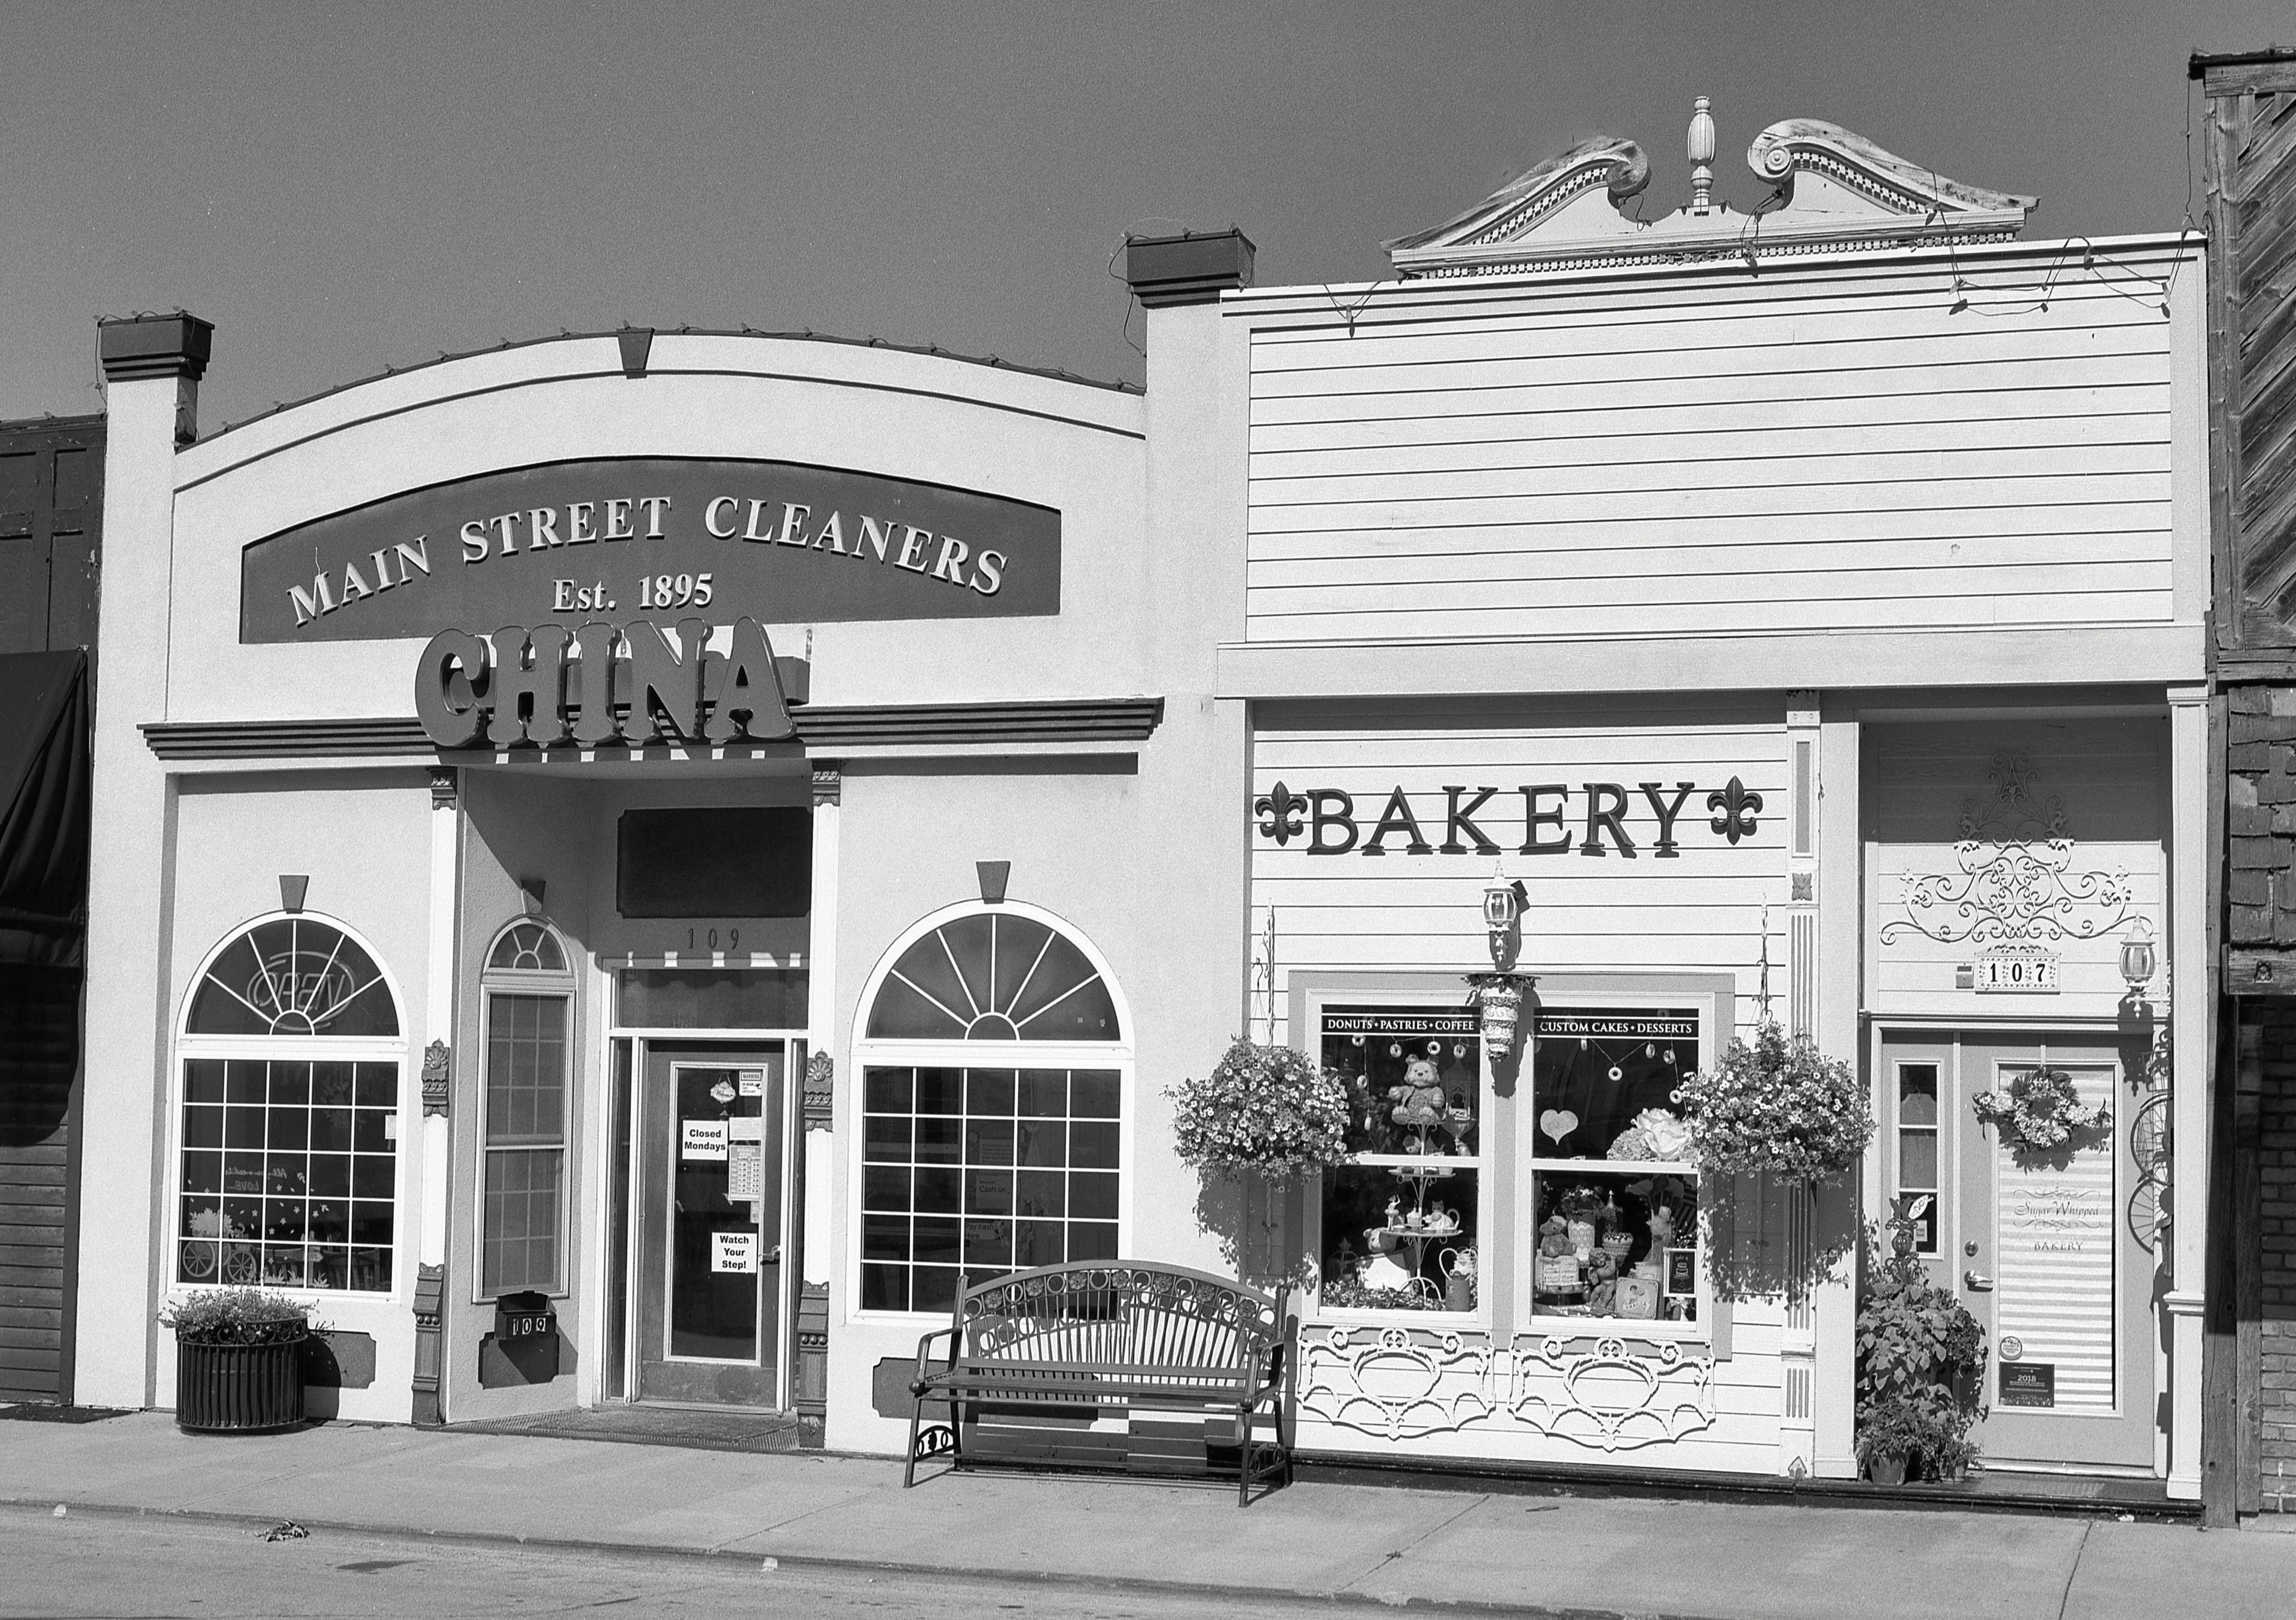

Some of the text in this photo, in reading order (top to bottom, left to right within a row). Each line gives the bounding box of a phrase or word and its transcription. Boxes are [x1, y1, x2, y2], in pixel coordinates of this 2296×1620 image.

[286, 496, 1009, 628] MAIN STREET CLEANERS
[552, 573, 713, 612] Est. 1895
[415, 616, 797, 747] CHINA
[1306, 782, 1695, 858] BAKERY
[689, 928, 739, 950] 109
[1990, 962, 2045, 982] 107
[254, 971, 345, 1010] OPEN
[1328, 1019, 1474, 1031] DONUTS PASTRIES COFFEE
[1540, 1022, 1692, 1034] CUSTOM CAKES DESSERTS
[689, 1129, 721, 1138] Closed
[685, 1141, 726, 1152] Mondays
[720, 1235, 749, 1244] Watch
[2034, 1241, 2083, 1251] BAKERY
[723, 1248, 746, 1256] Your
[722, 1260, 746, 1270] Step!
[512, 1317, 546, 1335] 109
